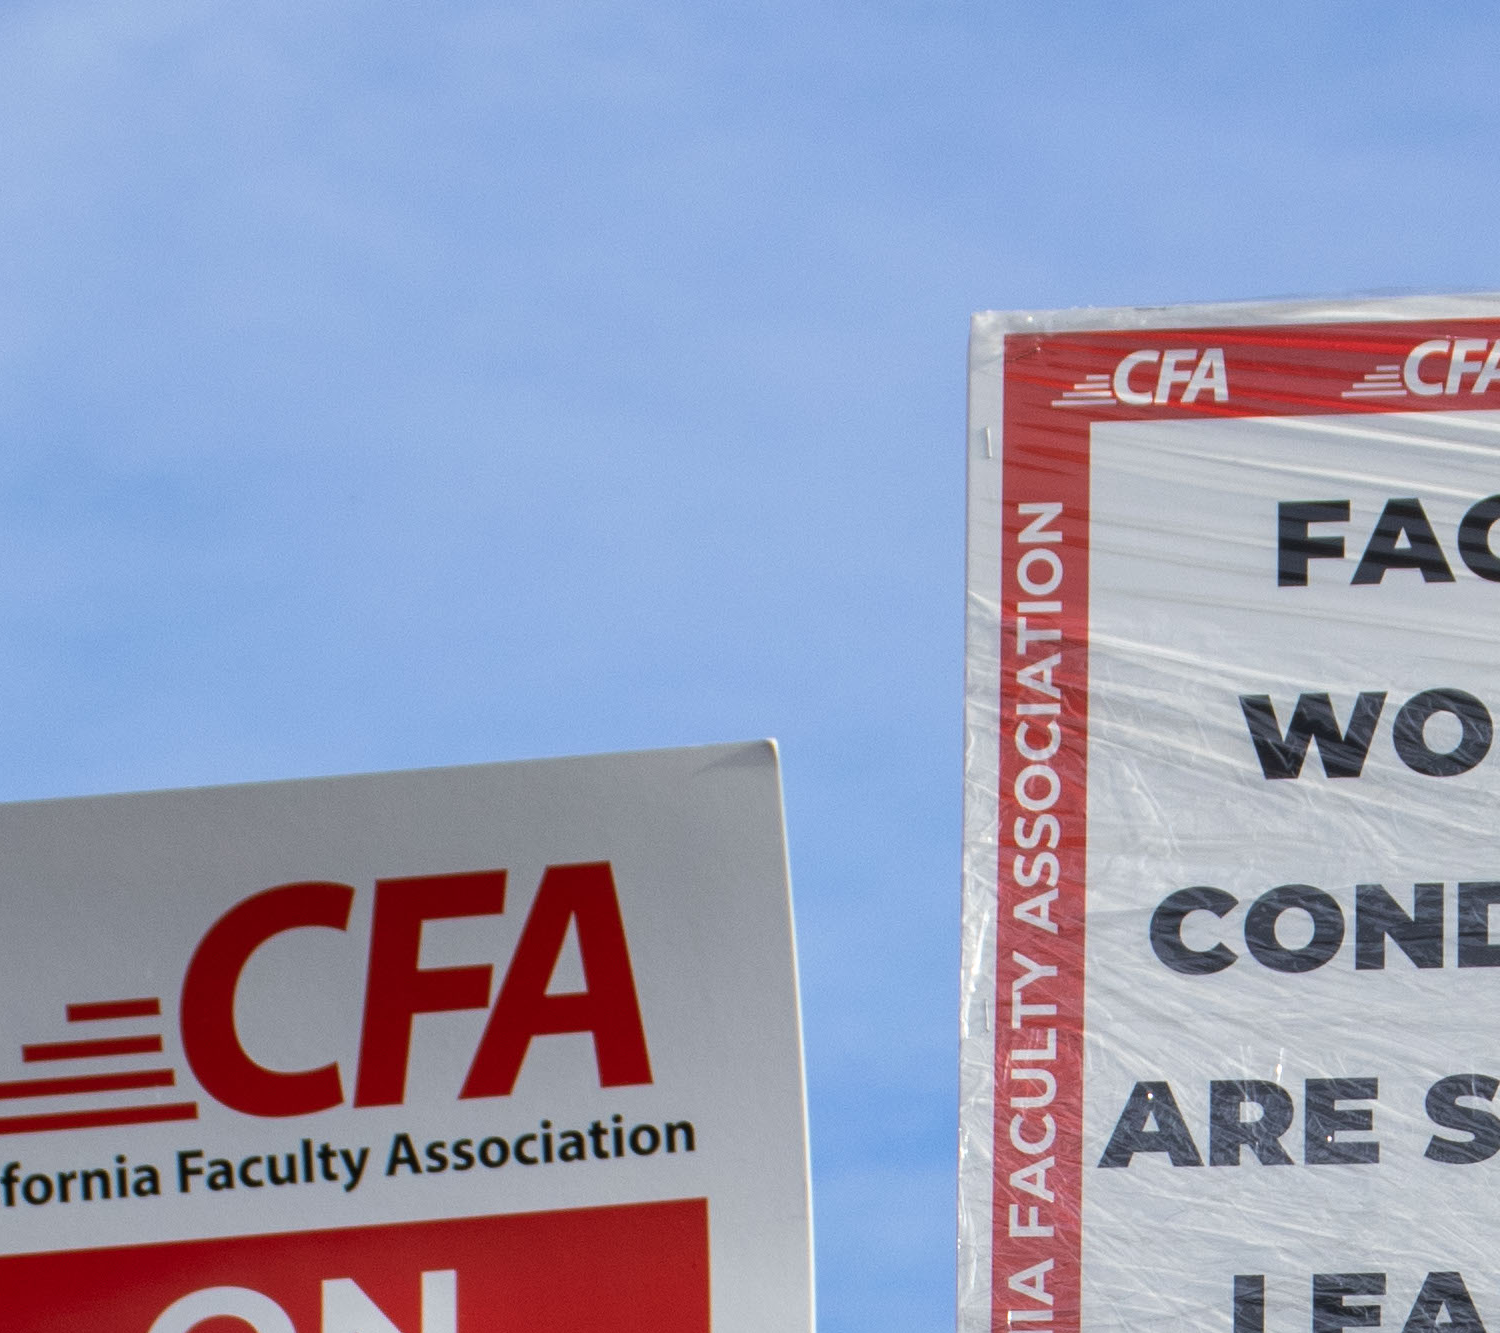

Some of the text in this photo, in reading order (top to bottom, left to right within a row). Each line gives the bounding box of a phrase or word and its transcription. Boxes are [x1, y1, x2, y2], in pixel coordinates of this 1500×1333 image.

[1112, 347, 1230, 405] CFA
[1012, 501, 1064, 935] ASSOCIATION
[179, 860, 655, 1119] CFA
[176, 1137, 371, 1194] Faculty
[385, 1113, 696, 1178] Association
[1008, 949, 1058, 1238] FACULTY
[1097, 1076, 1381, 1169] ARE
